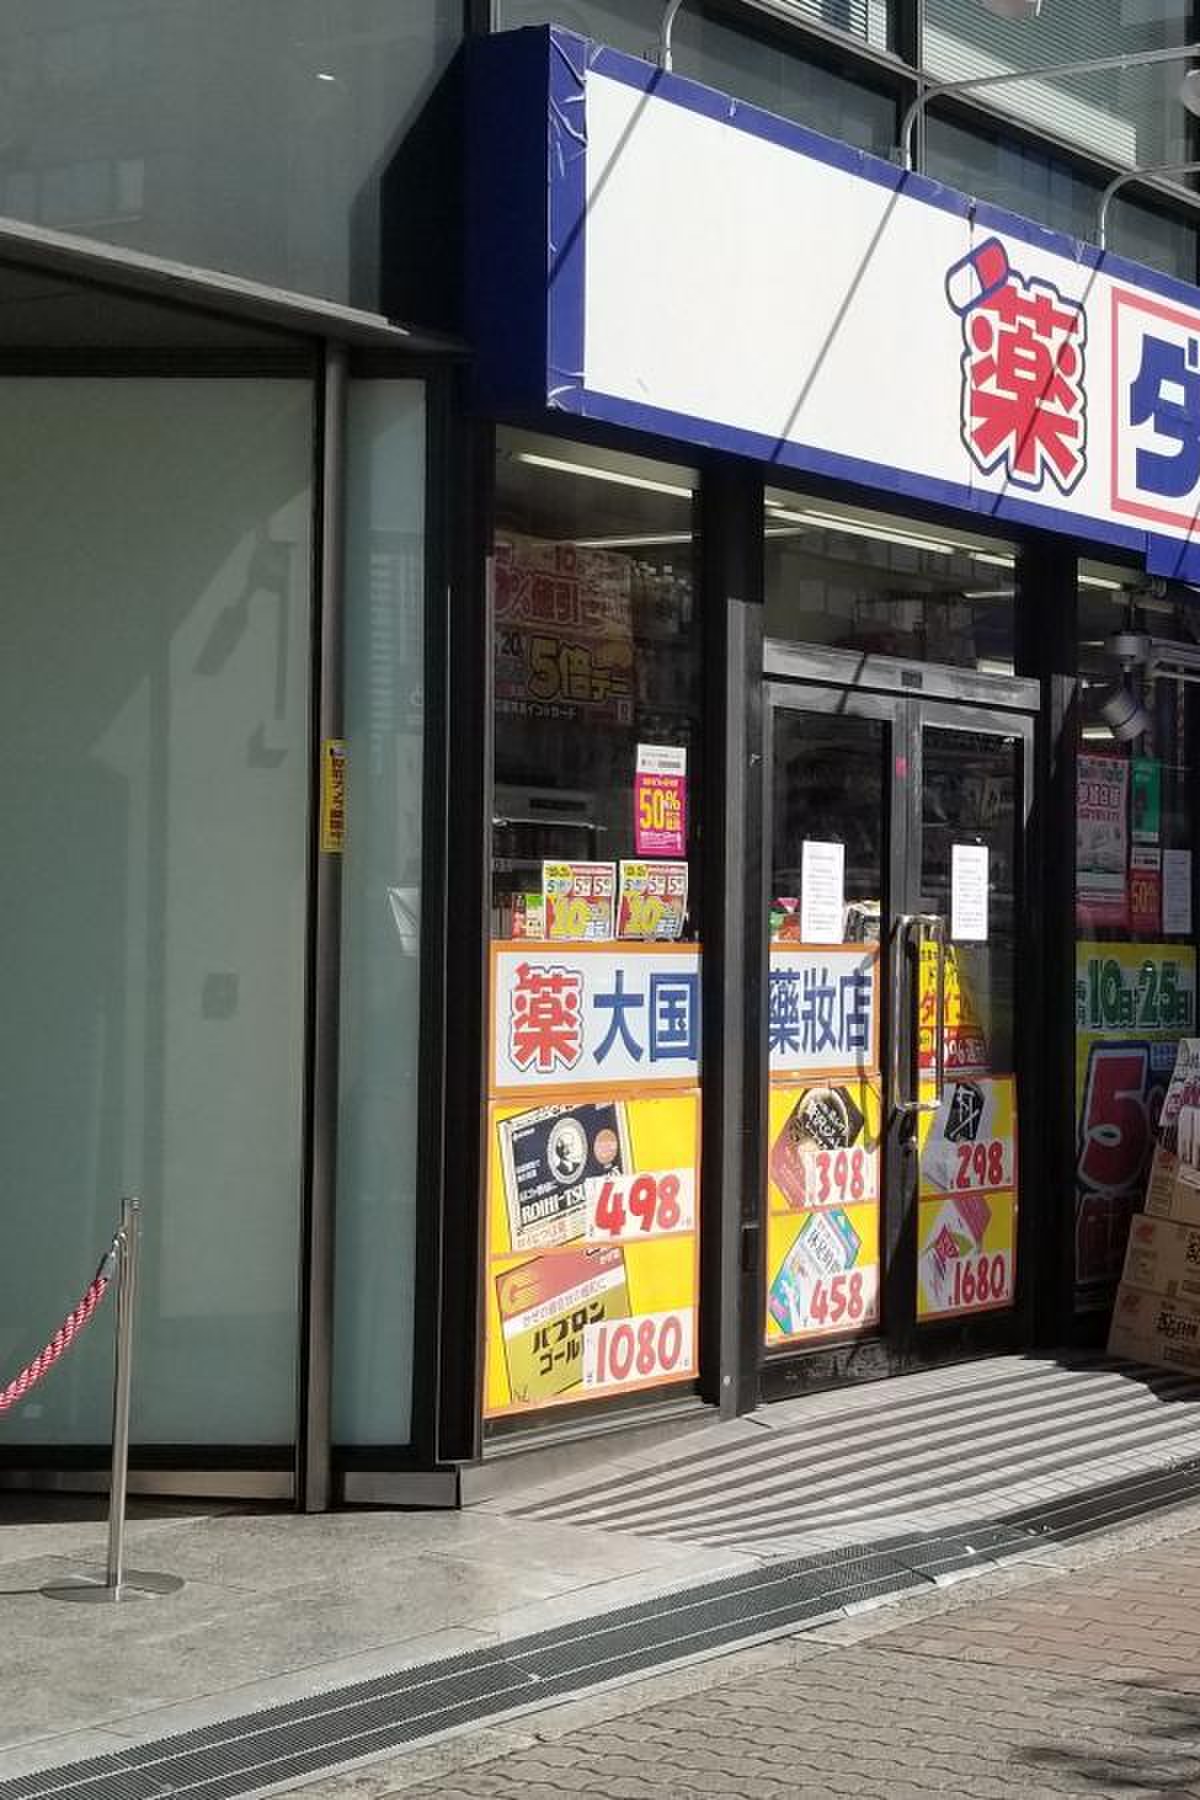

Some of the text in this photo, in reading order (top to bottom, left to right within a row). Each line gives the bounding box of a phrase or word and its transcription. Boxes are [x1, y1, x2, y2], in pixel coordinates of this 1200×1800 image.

[961, 268, 1087, 497] 薬
[510, 963, 584, 1073] 薬
[592, 969, 699, 1064] 大国
[816, 1149, 865, 1203] 398
[956, 1141, 1004, 1189] 298
[595, 1175, 681, 1236] 498
[810, 1273, 865, 1325] 458
[953, 1254, 1005, 1305] 1680
[597, 1315, 684, 1383] 1080
